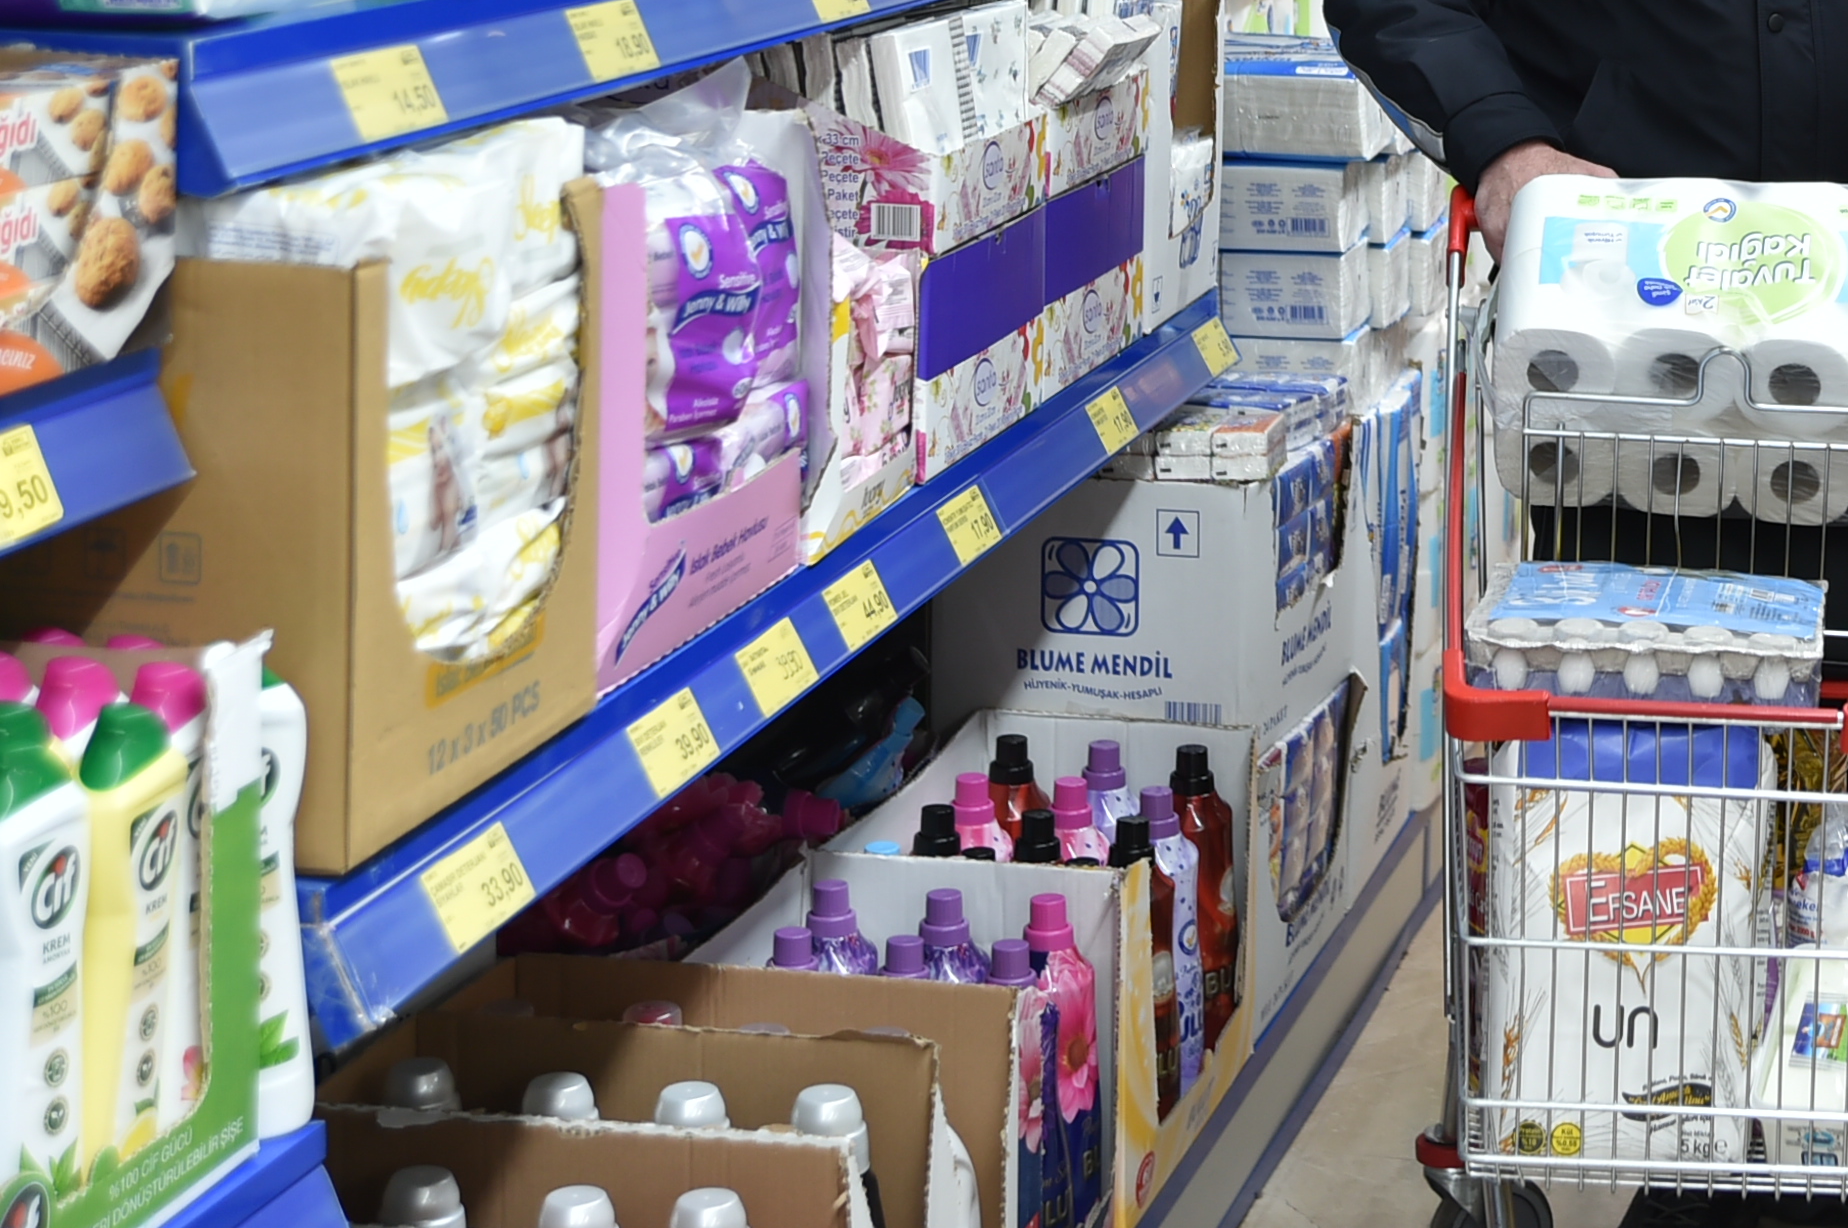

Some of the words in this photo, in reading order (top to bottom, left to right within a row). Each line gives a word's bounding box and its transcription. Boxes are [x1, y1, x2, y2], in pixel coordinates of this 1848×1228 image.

[826, 133, 839, 146] 33
[842, 135, 859, 147] cm
[827, 188, 859, 201] Paket
[830, 208, 859, 221] eçete
[1684, 258, 1817, 291] Tuvalet
[684, 294, 715, 318] Jenny
[715, 296, 725, 311] &
[725, 292, 751, 313] Willy
[1701, 295, 1716, 310] 2
[1281, 626, 1309, 667] BLUME
[1016, 648, 1086, 674] BLUME
[1090, 650, 1173, 679] MENDİL
[428, 739, 445, 776] 12
[462, 728, 474, 755] 3
[512, 679, 542, 723] PCS
[675, 723, 710, 760] 39,90
[141, 817, 176, 884] Cif
[35, 852, 77, 923] Cif
[480, 861, 524, 908] 33,90
[1584, 879, 1686, 923] EFSANE
[145, 894, 169, 915] KREM
[42, 932, 71, 955] KREM
[1592, 1003, 1660, 1050] un
[161, 1127, 193, 1161] GÜCÜ
[220, 1115, 245, 1149] ŞİŞE
[1681, 1138, 1691, 1154] 5
[1692, 1135, 1712, 1158] kg
